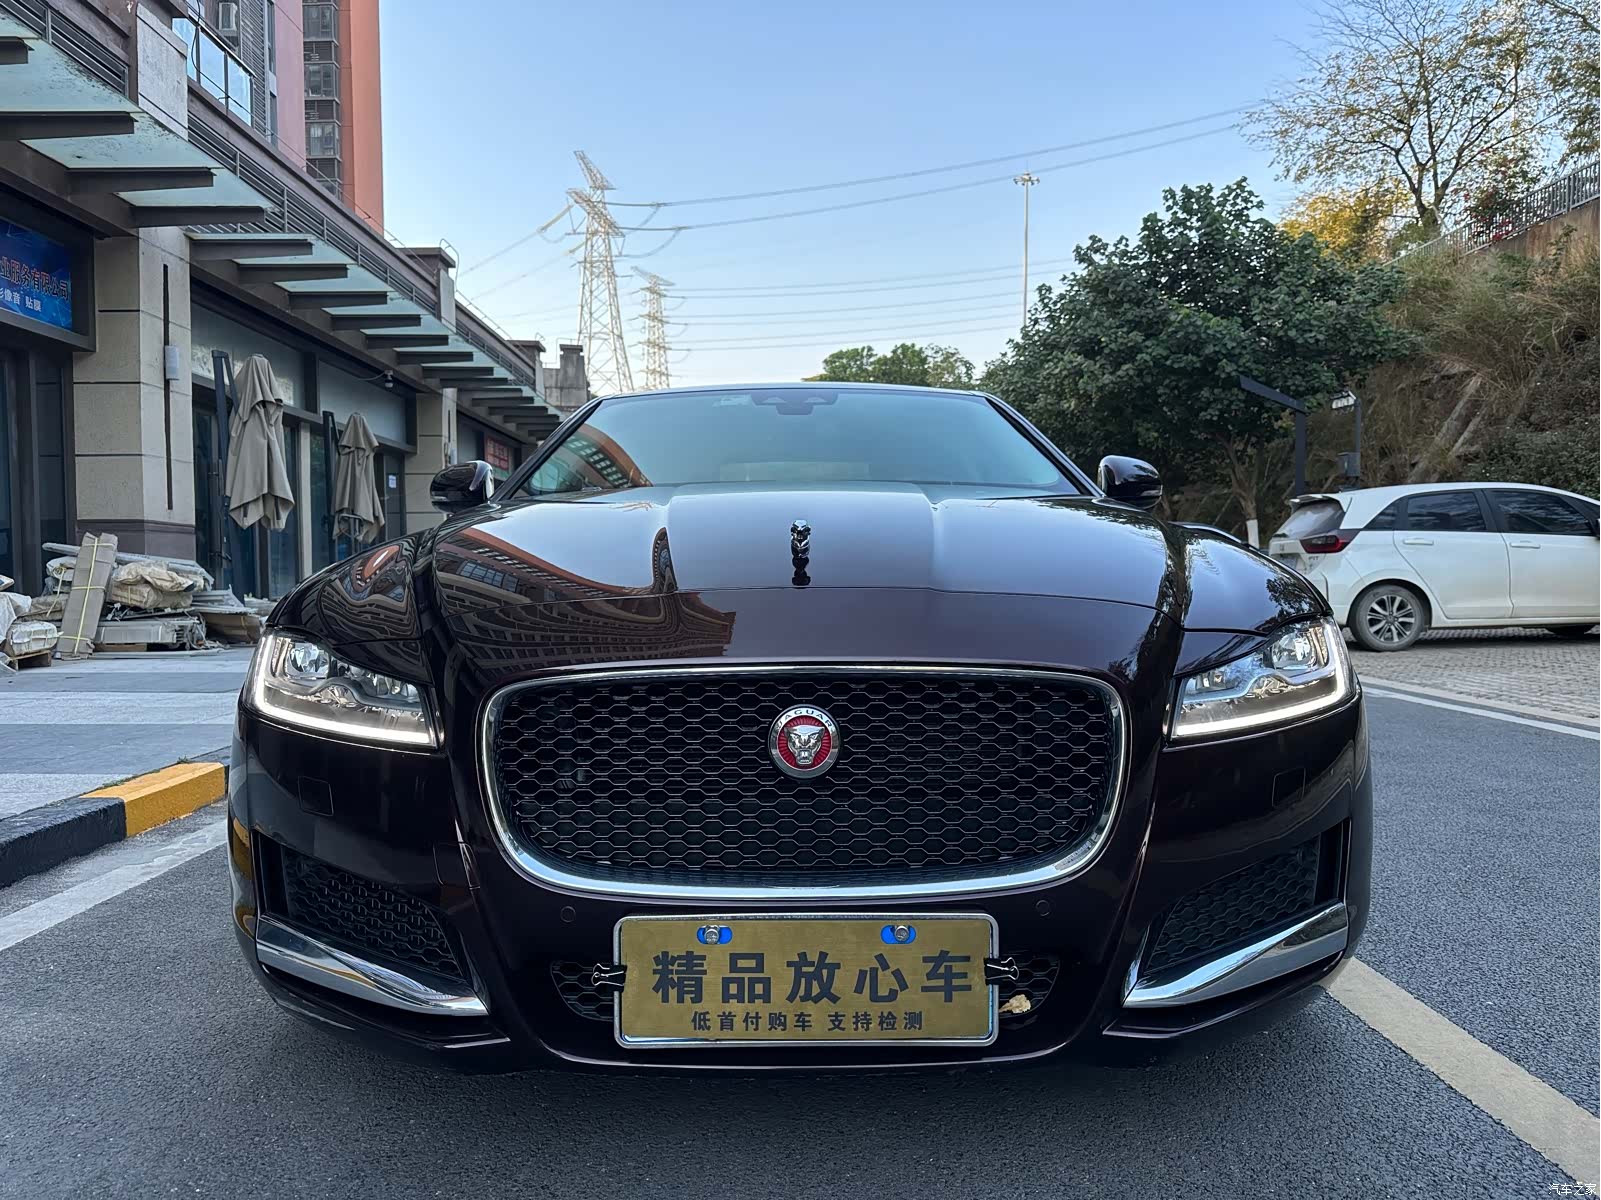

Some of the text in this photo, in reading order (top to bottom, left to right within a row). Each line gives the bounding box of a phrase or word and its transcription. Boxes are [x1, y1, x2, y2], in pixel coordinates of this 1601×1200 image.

[775, 710, 832, 730] JAGUAR
[651, 949, 973, 1005] 精品放心车
[691, 1010, 924, 1032] 低首付购车 支持检测
